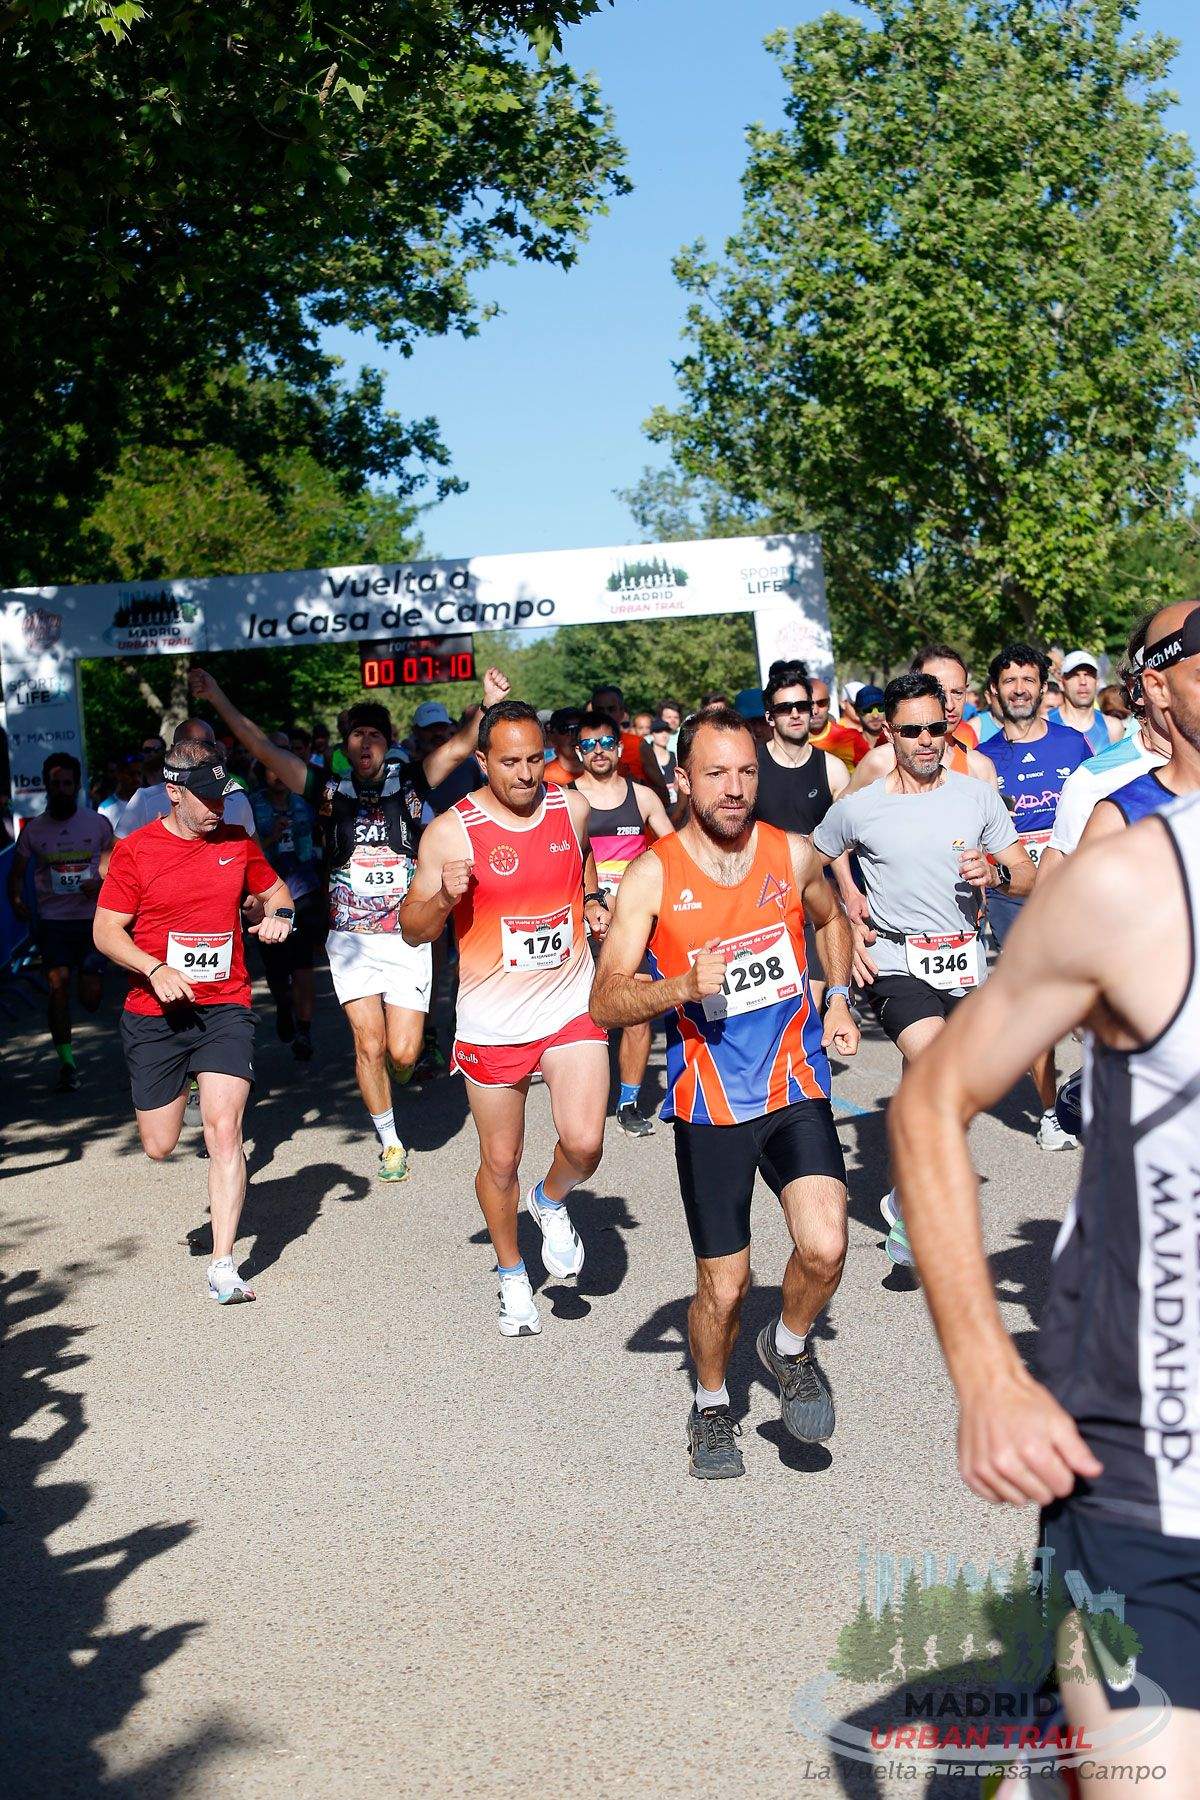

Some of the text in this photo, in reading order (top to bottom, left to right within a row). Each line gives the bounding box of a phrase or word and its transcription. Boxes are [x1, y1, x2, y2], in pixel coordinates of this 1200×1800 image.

[740, 567, 787, 580] SPORT
[327, 570, 470, 599] Vuelta a
[748, 580, 783, 594] LIFE
[621, 591, 674, 602] MADRID
[609, 600, 685, 615] URBAN TRAIL
[247, 598, 556, 639] la Casa de Campo
[128, 627, 181, 638] MADRID
[117, 637, 194, 650] URBAN TRAIL
[1163, 638, 1183, 660] MA
[7, 678, 54, 693] SPORT
[17, 691, 51, 705] LIFE
[27, 730, 76, 743] MADRID
[13, 774, 42, 788] Ibe
[60, 875, 81, 886] 857
[364, 871, 394, 885] 433
[523, 931, 562, 955] 176
[738, 938, 753, 948] Casa
[753, 936, 762, 944] de
[761, 930, 782, 941] Campo
[183, 952, 219, 968] 944
[919, 952, 968, 975] 1346
[720, 956, 785, 996] 1298
